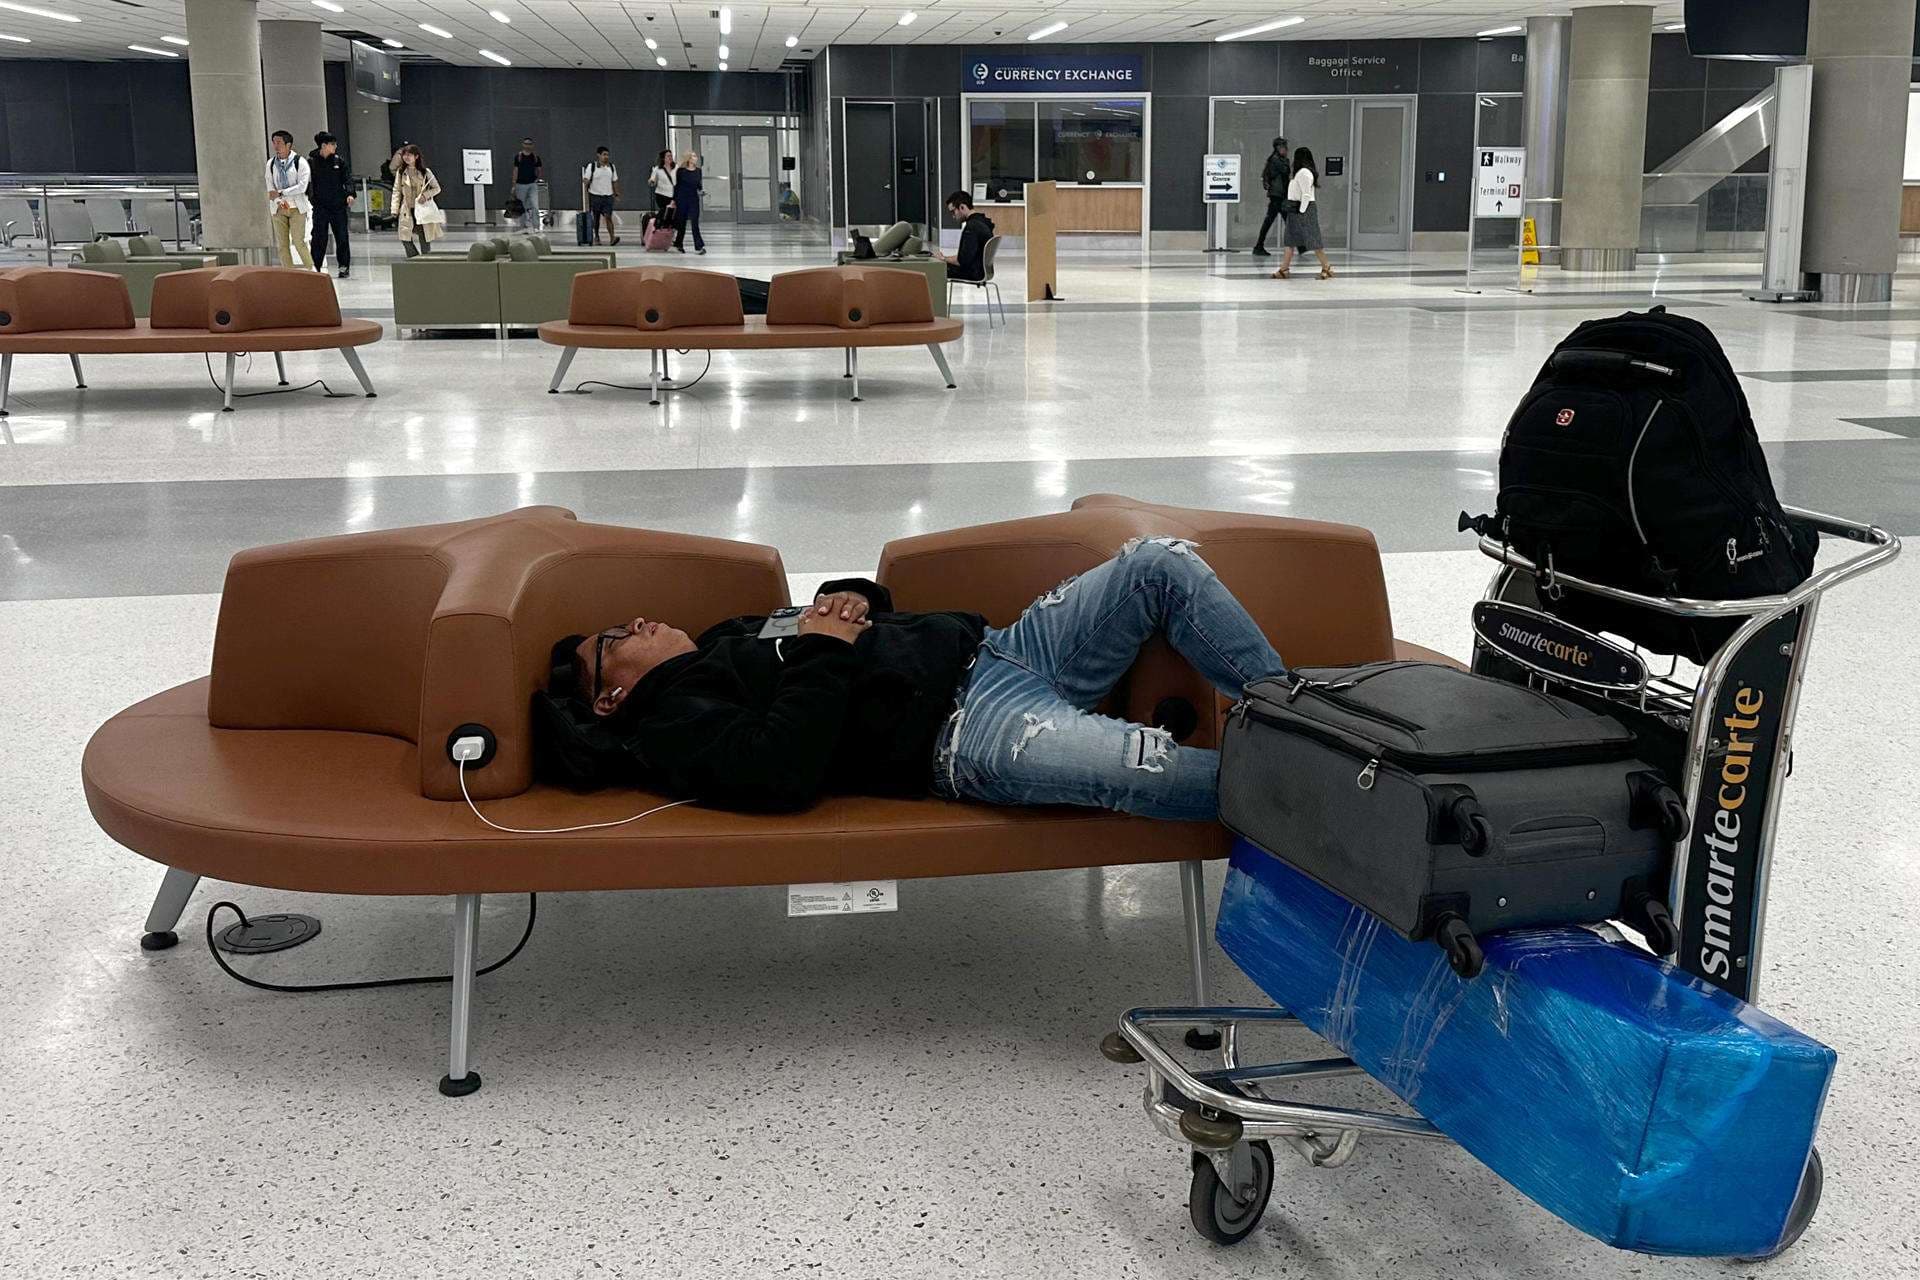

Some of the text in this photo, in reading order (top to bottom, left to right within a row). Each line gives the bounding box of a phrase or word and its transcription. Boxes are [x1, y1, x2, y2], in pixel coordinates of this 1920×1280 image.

[1308, 56, 1386, 67] Baggage Service
[994, 69, 1132, 81] CURRENCY EXCHANGE
[1330, 68, 1363, 77] Office
[1494, 154, 1522, 166] Walkway
[1496, 175, 1506, 184] to
[1479, 186, 1520, 197] Terminal D
[1498, 622, 1589, 667] smartecarte
[1701, 687, 1764, 981] smartecarte
